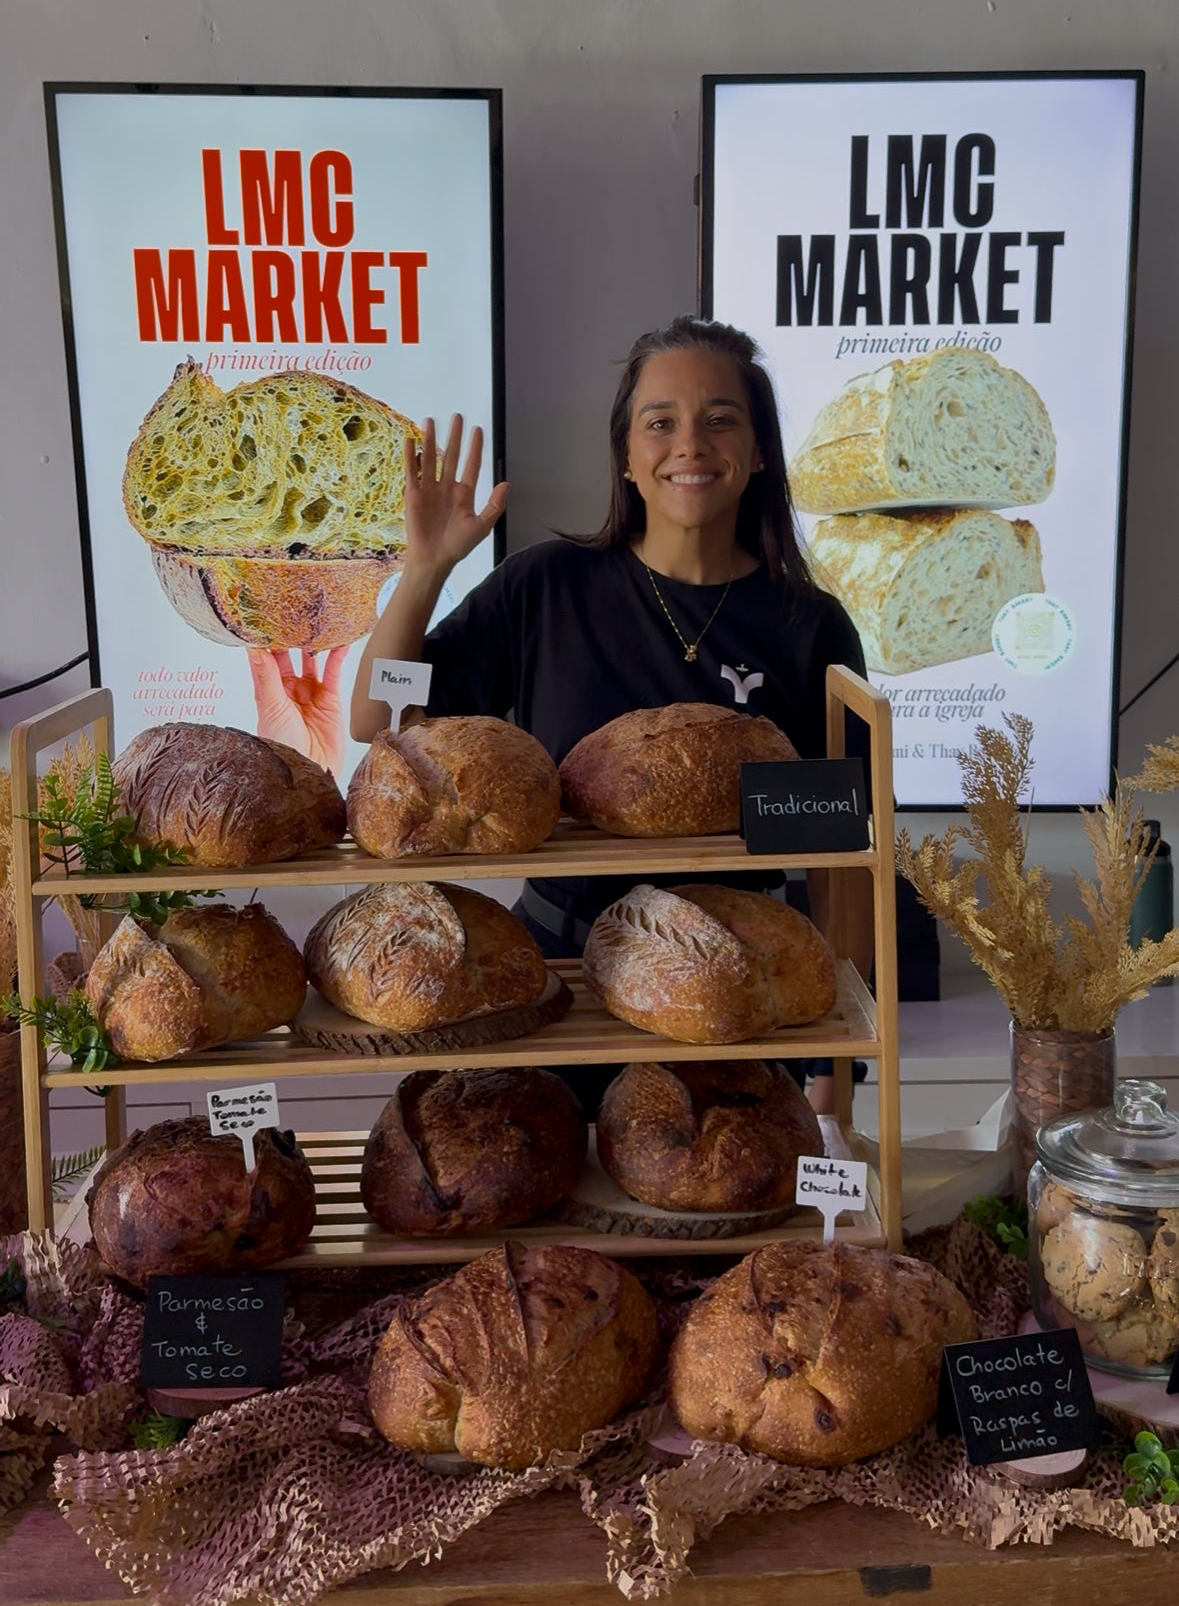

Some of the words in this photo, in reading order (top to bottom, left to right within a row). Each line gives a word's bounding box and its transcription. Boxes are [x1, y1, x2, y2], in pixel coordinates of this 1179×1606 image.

[849, 133, 996, 229] LMC
[202, 149, 354, 247] LMC
[775, 231, 1065, 327] MARKET
[133, 248, 428, 344] MARKET
[834, 332, 930, 359] primeira
[205, 349, 299, 374] primeira
[305, 349, 371, 376] edição
[138, 666, 173, 682] todo
[177, 666, 218, 682] valor
[381, 670, 412, 686] Plain
[132, 683, 224, 699] arrecadado
[904, 683, 1006, 704] arrecadado
[918, 703, 931, 718] a
[934, 701, 986, 723] igreja
[911, 743, 925, 758] &
[747, 788, 860, 817] Tradicional
[211, 1106, 268, 1120] Tomate
[802, 1162, 850, 1179] White
[157, 1287, 265, 1313] Parmesão
[151, 1333, 243, 1358] Tomate
[955, 1342, 1065, 1377] Chocolate
[968, 1380, 1043, 1404] Branco
[1054, 1368, 1073, 1393] c/
[968, 1411, 1042, 1437] Raspas
[1052, 1400, 1080, 1418] de
[999, 1428, 1058, 1453] Limão
